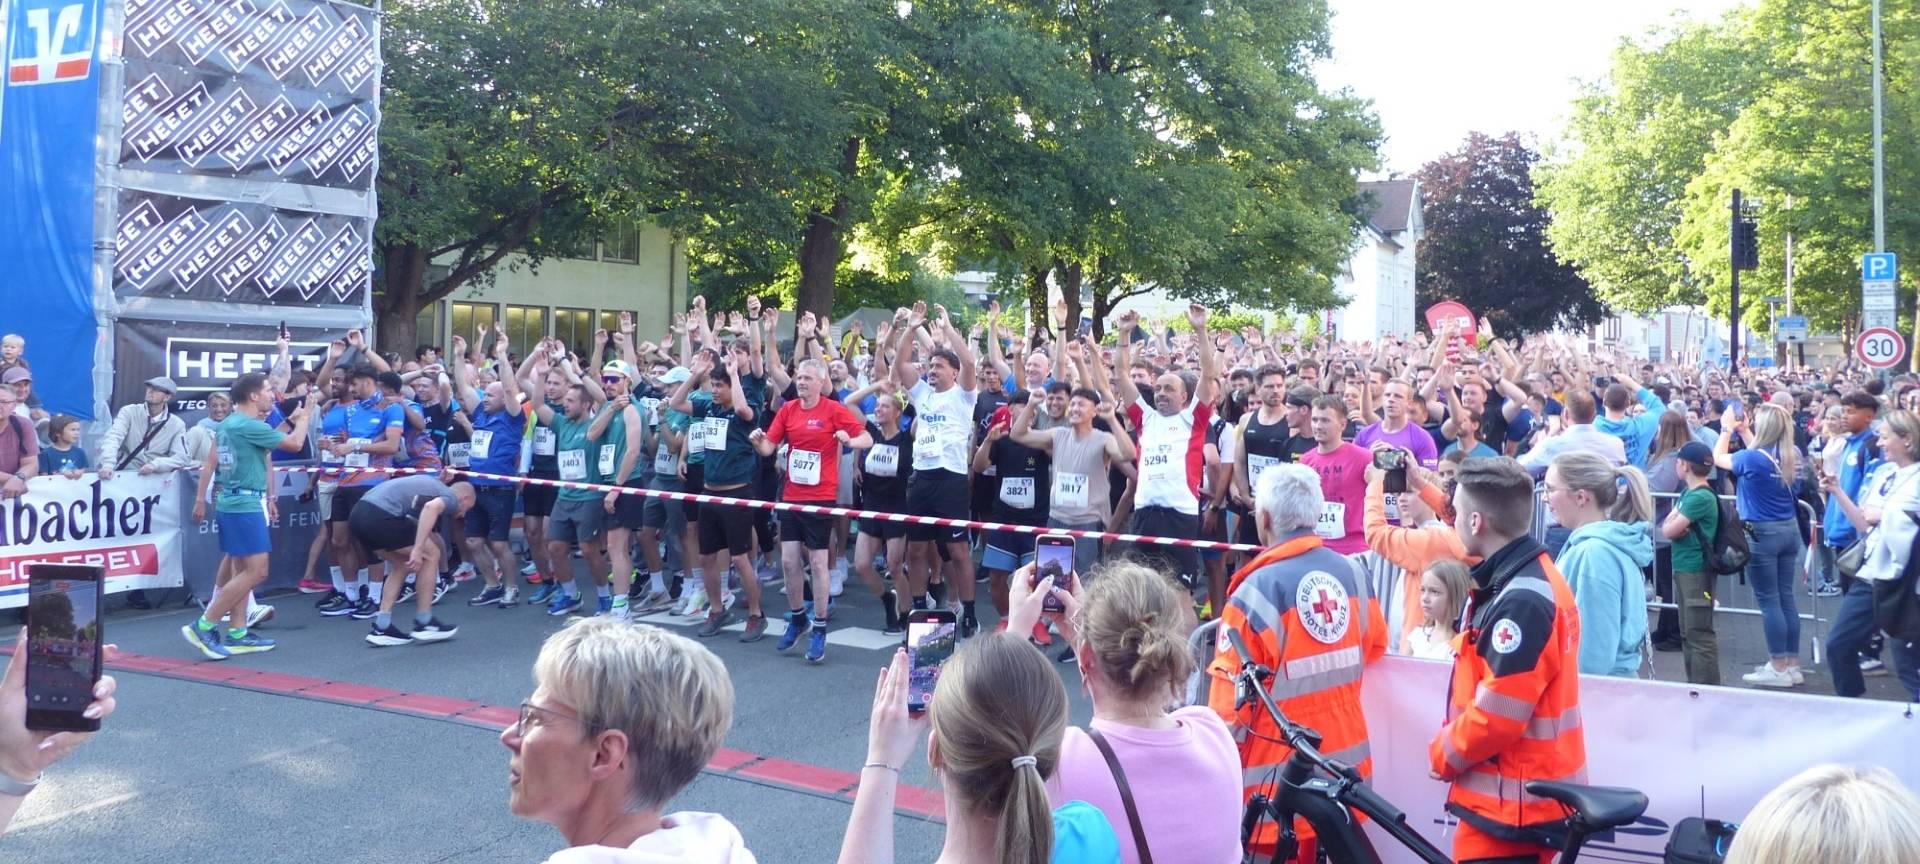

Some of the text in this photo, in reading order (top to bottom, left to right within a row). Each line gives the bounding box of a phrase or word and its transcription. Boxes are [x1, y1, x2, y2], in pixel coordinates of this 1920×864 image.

[138, 0, 205, 48] HEEE
[186, 0, 245, 56] HEEET
[228, 7, 286, 64] HEEET
[270, 15, 322, 71] HEEET
[309, 22, 359, 78] HEEET
[343, 48, 374, 85] HEE
[123, 82, 160, 123] EET
[138, 91, 203, 153] HEEET
[184, 97, 245, 159] HEEET
[225, 103, 287, 162] HEEET
[271, 109, 324, 166] HEEET
[310, 112, 363, 170] HEEET
[345, 135, 376, 173] HEE
[116, 209, 150, 252] EET
[129, 214, 196, 280] HEEET
[178, 217, 243, 282] HEEET
[221, 223, 278, 286] HEEET
[263, 227, 316, 289] HEEET
[301, 231, 352, 292] HEEET
[336, 254, 369, 293] HEE
[1870, 257, 1887, 278] P
[1866, 338, 1894, 357] 30
[793, 458, 815, 471] 5077
[1144, 454, 1168, 467] 5294
[1006, 486, 1028, 496] 3821
[1301, 576, 1342, 603] DEUTSCHES
